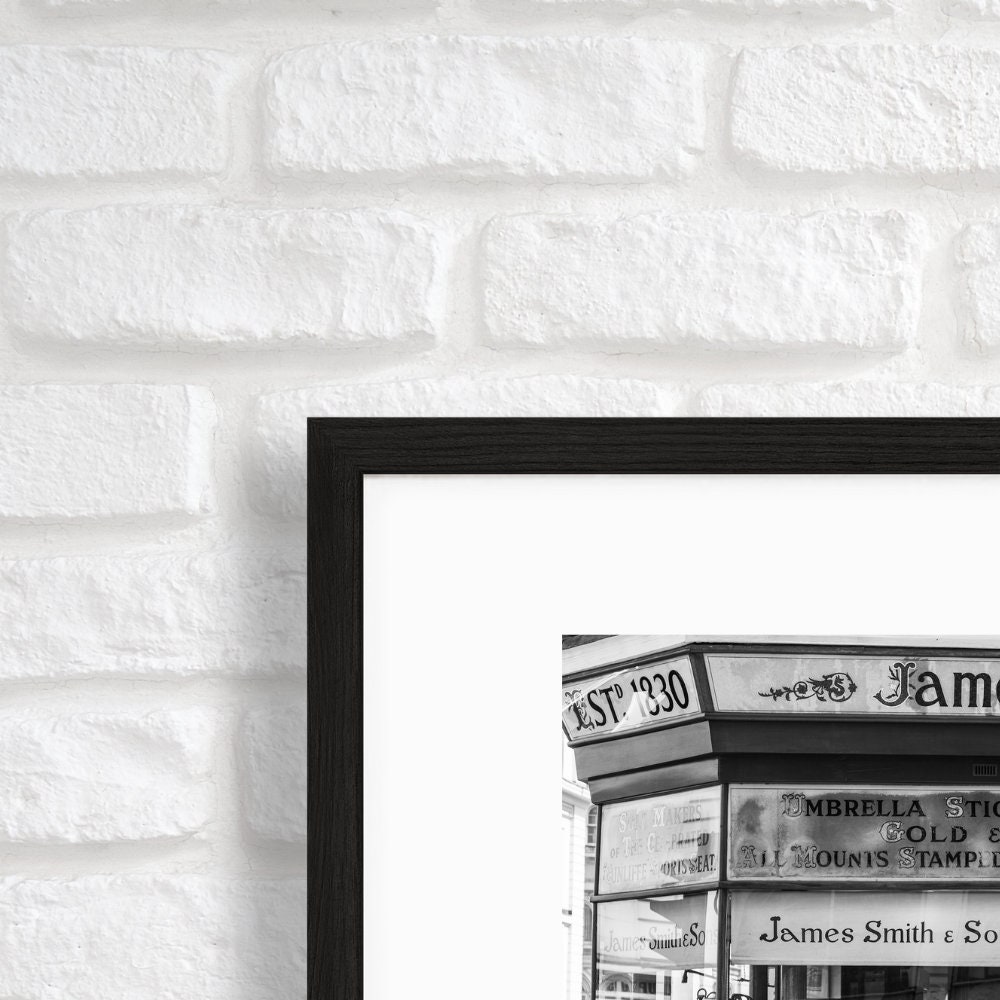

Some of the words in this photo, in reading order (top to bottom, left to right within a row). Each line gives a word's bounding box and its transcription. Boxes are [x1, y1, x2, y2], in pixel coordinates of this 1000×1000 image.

[630, 669, 689, 717] 1830
[782, 792, 926, 818] UMBRELLA
[879, 821, 968, 843] GOLD
[790, 845, 889, 869] MOUNTS
[759, 916, 854, 943] James
[863, 920, 933, 943] Smith
